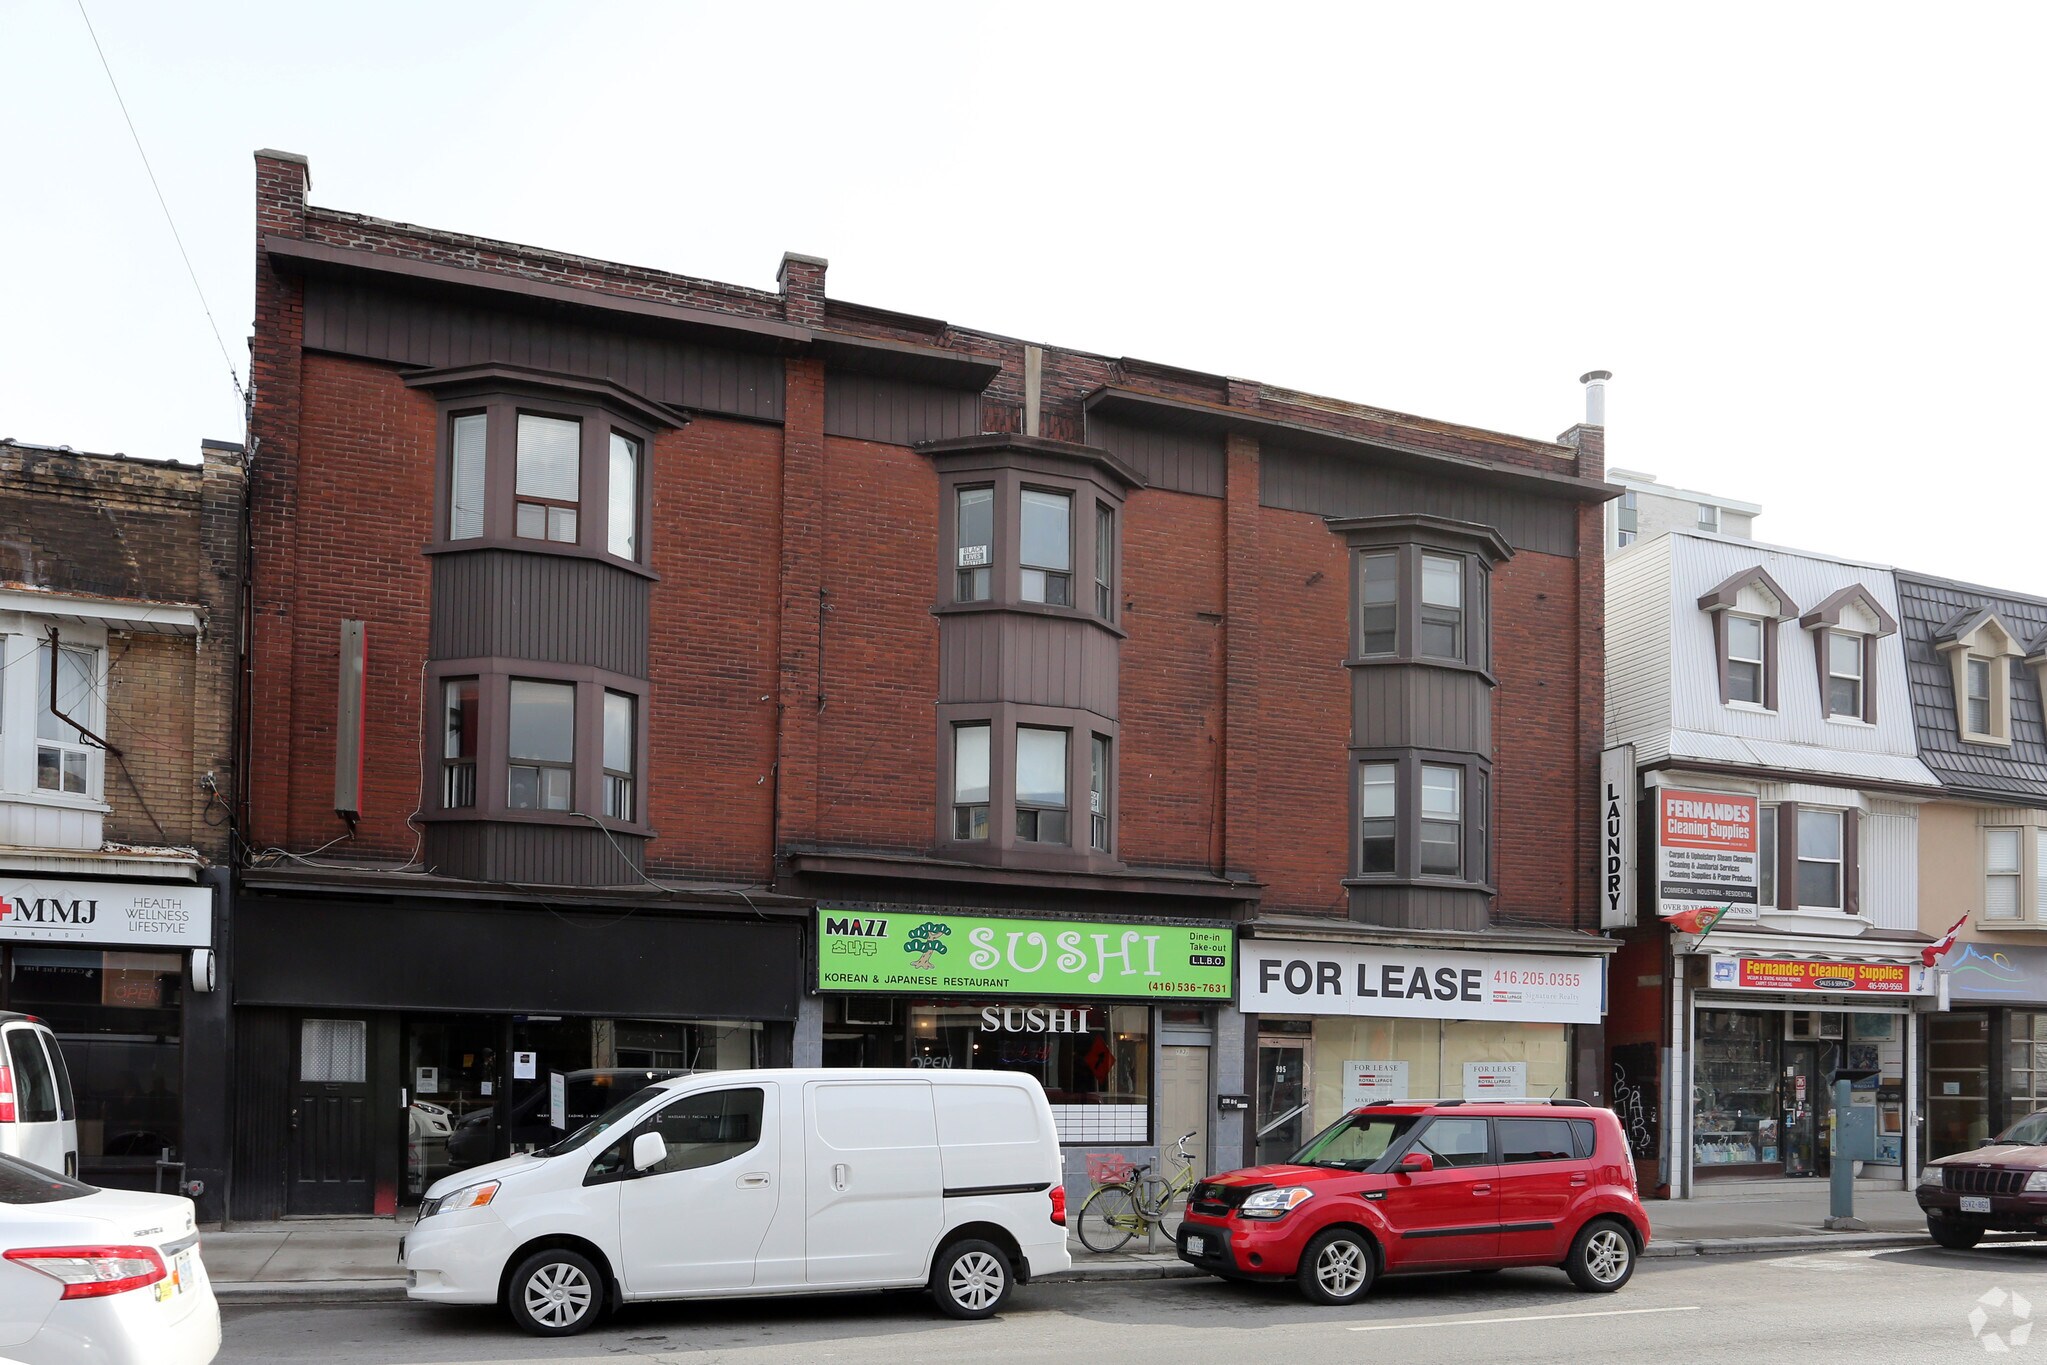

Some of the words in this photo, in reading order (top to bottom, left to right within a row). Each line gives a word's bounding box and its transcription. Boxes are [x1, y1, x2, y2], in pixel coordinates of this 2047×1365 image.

[1667, 799, 1750, 823] FERNANDES
[1667, 818, 1709, 839] Cleaning
[1710, 822, 1750, 840] Supplies
[1607, 783, 1621, 911] LAUNDRY
[1669, 850, 1685, 859] Carpet
[1691, 852, 1716, 861] Upholstery
[1733, 855, 1753, 864] Cleaning
[1669, 861, 1690, 869] Cleaning
[1696, 862, 1719, 871] Janitorial
[1719, 864, 1740, 872] Services
[1669, 871, 1690, 880] Cleaning
[1691, 872, 1711, 880] Supplies
[1717, 873, 1731, 881] Paper
[1731, 874, 1752, 882] Products
[1663, 886, 1694, 895] COMMERCIAL
[1696, 888, 1722, 896] INDUSTRIAL
[1725, 890, 1753, 898] RESIDENTIAL
[13, 897, 99, 924] MMJ
[133, 897, 182, 910] HEALTH
[1663, 903, 1682, 911] OVER
[1723, 906, 1753, 914] SINESS
[125, 908, 190, 922] WELLNESS
[129, 921, 186, 934] LIFESTYLE
[826, 917, 888, 937] MAZZ
[1189, 932, 1220, 942] Dine-in
[832, 940, 877, 956] 소나무
[1189, 942, 1227, 952] Take-out
[968, 927, 1162, 983] SUSHI
[1192, 956, 1224, 966] L.L.B.O.
[1747, 961, 1805, 976] Fernandes
[1809, 963, 1855, 980] Cleaning
[1859, 965, 1904, 981] Supplies
[824, 973, 868, 983] KOREAN
[873, 975, 879, 983] &
[884, 975, 938, 985] JAPANESE
[943, 977, 1010, 987] RESTAURANT
[1259, 959, 1342, 995] FOR
[1357, 963, 1482, 1002] LEASE
[1494, 970, 1580, 987] 416.205.0355
[113, 986, 161, 1001] OPEN
[1177, 982, 1227, 993] 536-7631
[1868, 982, 1903, 991] 416-990-9563
[1525, 992, 1556, 1001] Signature
[1559, 993, 1579, 1002] Realty
[980, 1006, 1090, 1034] SUSHI
[911, 1056, 953, 1068] OPEN
[1275, 1065, 1287, 1073] 995
